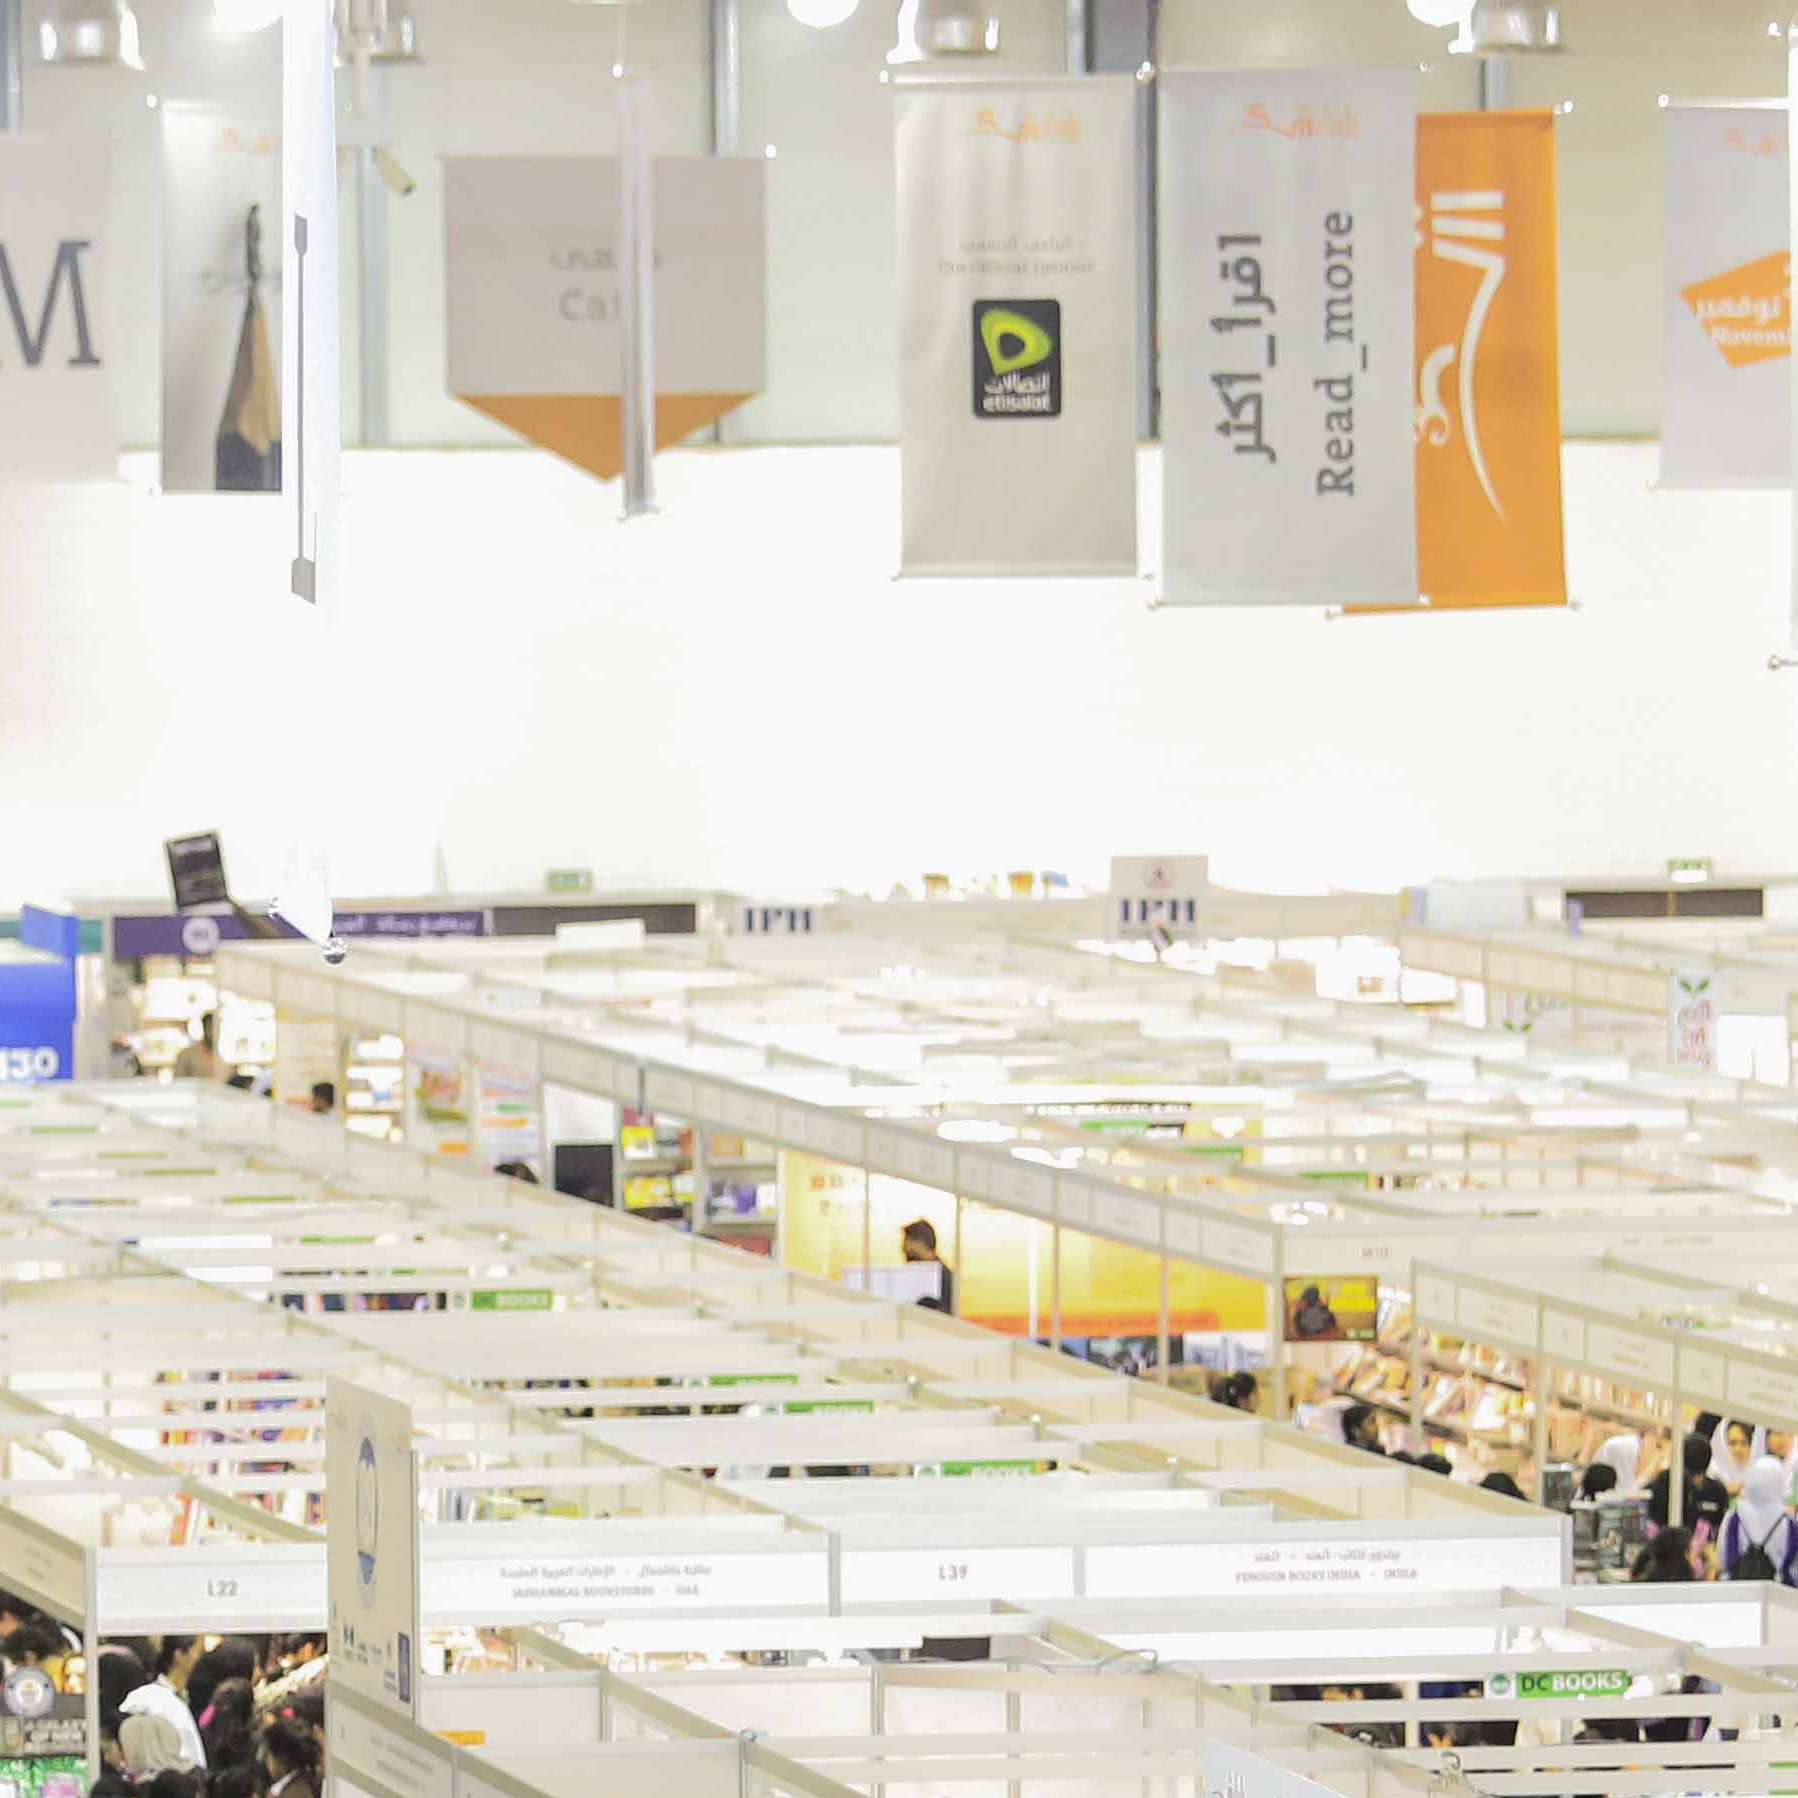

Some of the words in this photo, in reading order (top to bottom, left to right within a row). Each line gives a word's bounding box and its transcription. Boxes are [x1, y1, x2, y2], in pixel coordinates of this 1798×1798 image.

[1316, 210, 1370, 497] Read_more
[1521, 1673, 1549, 1693] DC
[1552, 1671, 1623, 1692] BOOKS
